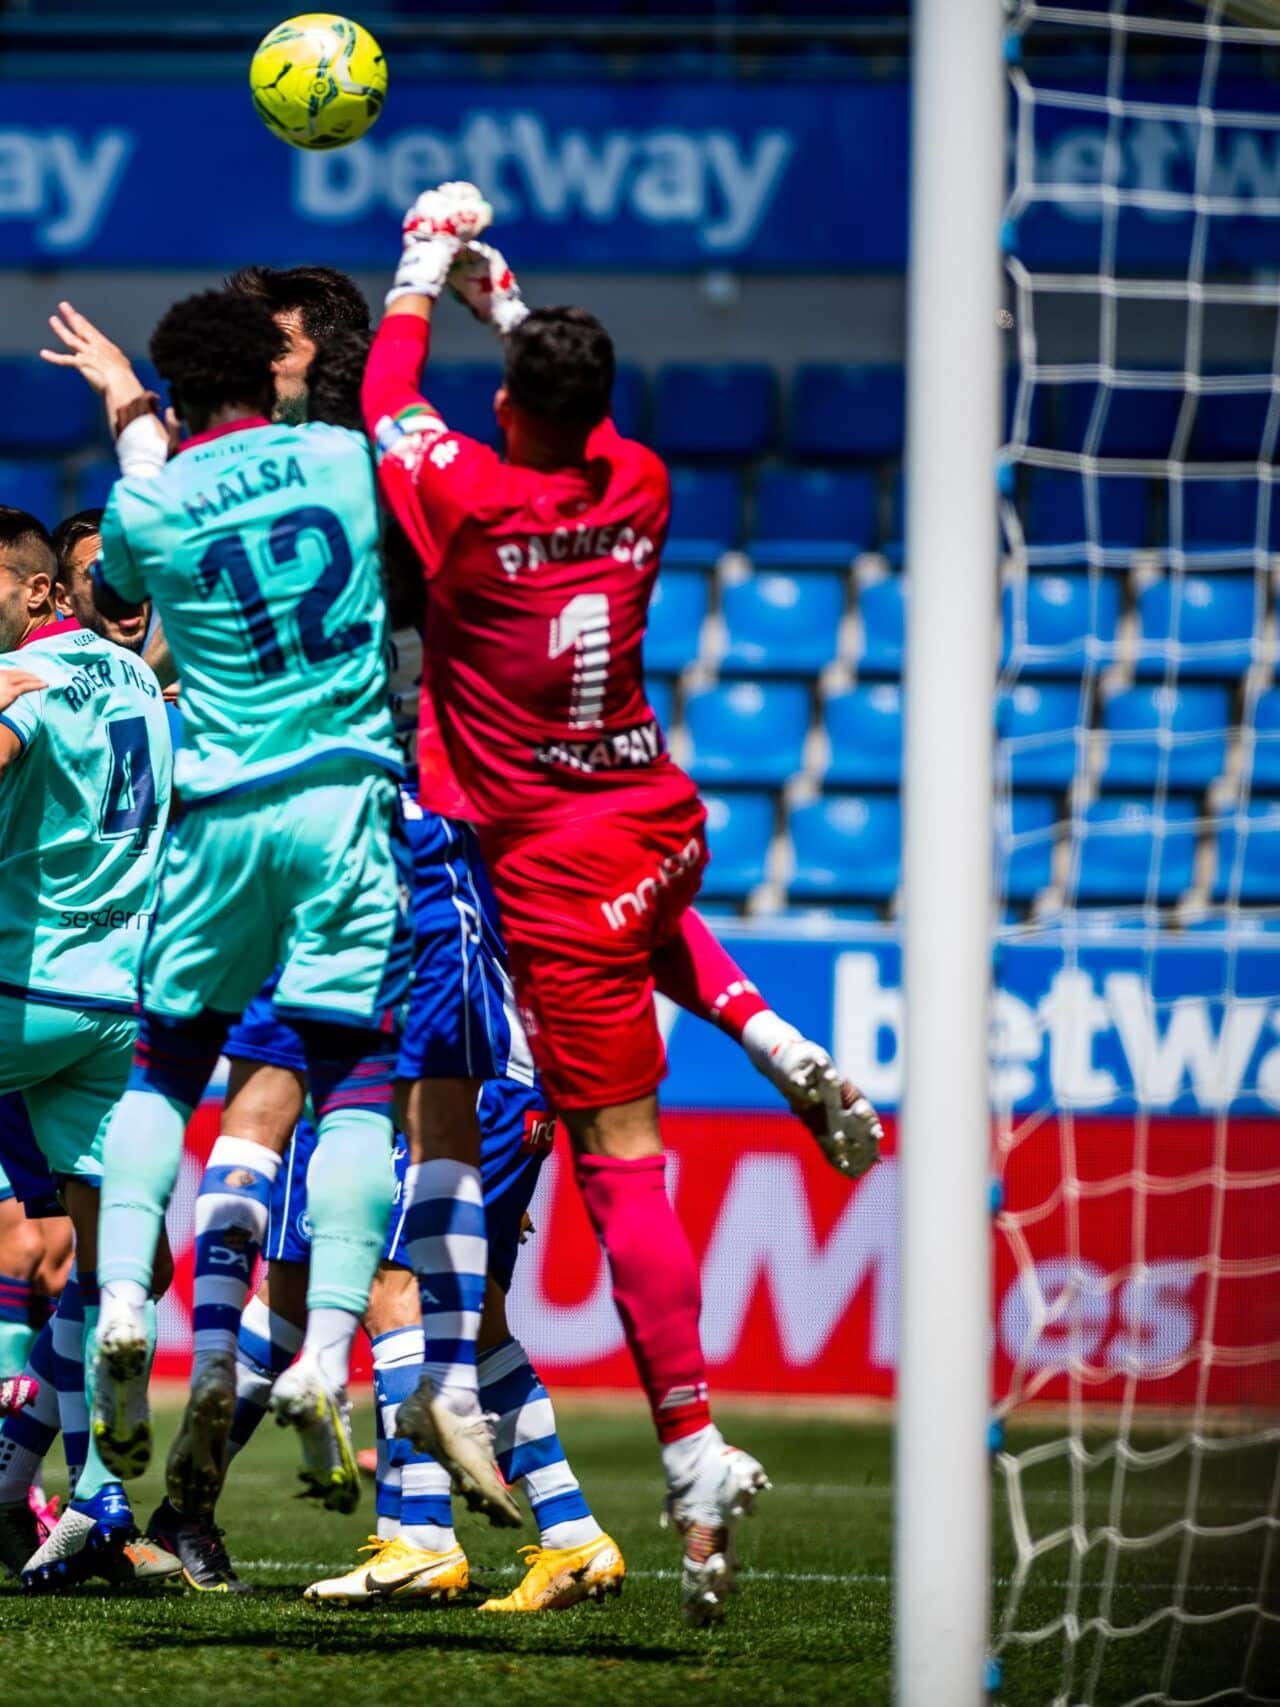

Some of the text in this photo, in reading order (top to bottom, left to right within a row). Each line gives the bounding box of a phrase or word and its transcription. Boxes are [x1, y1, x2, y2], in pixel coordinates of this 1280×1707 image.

[295, 115, 790, 247] betway
[182, 455, 308, 527] MALSA
[192, 504, 375, 684] 12
[547, 593, 611, 729] 1
[100, 715, 159, 858] 4
